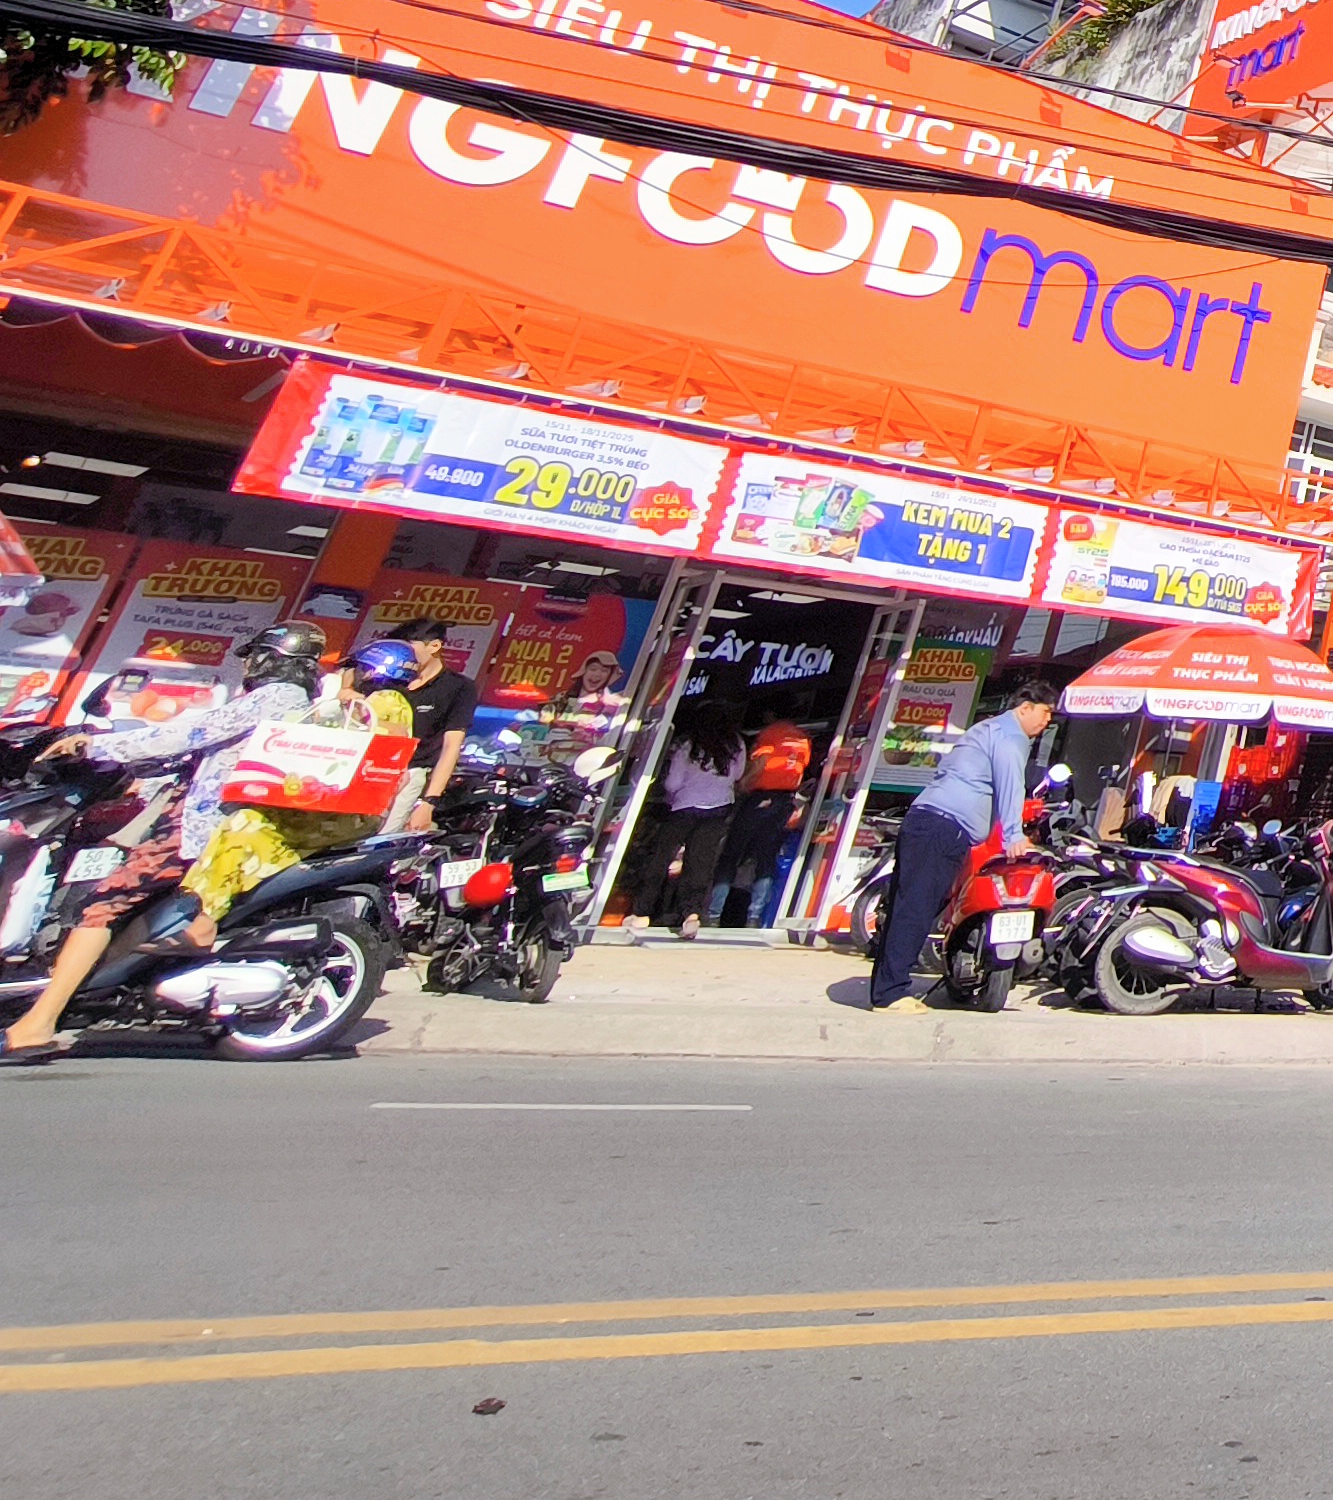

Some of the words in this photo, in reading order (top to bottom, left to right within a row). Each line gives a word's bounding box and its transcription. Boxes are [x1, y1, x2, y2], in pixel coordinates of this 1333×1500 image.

[1227, 19, 1306, 88] mart
[674, 31, 779, 109] THỊ
[797, 72, 955, 155] THỰC
[963, 130, 1115, 200] PHẨM
[504, 438, 596, 461] OLDENBURGER
[493, 455, 638, 509] 29.000
[902, 500, 949, 528] KEM
[950, 508, 994, 537] MUA
[998, 517, 1014, 539] 2
[917, 531, 973, 565] TẶNG
[976, 543, 987, 565] 1
[182, 559, 262, 578] KHAI
[149, 574, 281, 599] TRƯƠNG
[410, 586, 477, 604] KHAI
[1153, 564, 1248, 607] 149.000
[380, 602, 493, 621] TRƯƠNG
[506, 638, 552, 662] MUA
[556, 643, 574, 664] 2
[694, 629, 755, 663] CÂY
[918, 650, 964, 664] KHAI
[906, 663, 975, 678] RƯƠNG
[1191, 651, 1223, 664] SIÊU
[1225, 653, 1250, 667] THỊ
[1172, 667, 1212, 682] THỰC
[1212, 667, 1259, 683] PHẨM
